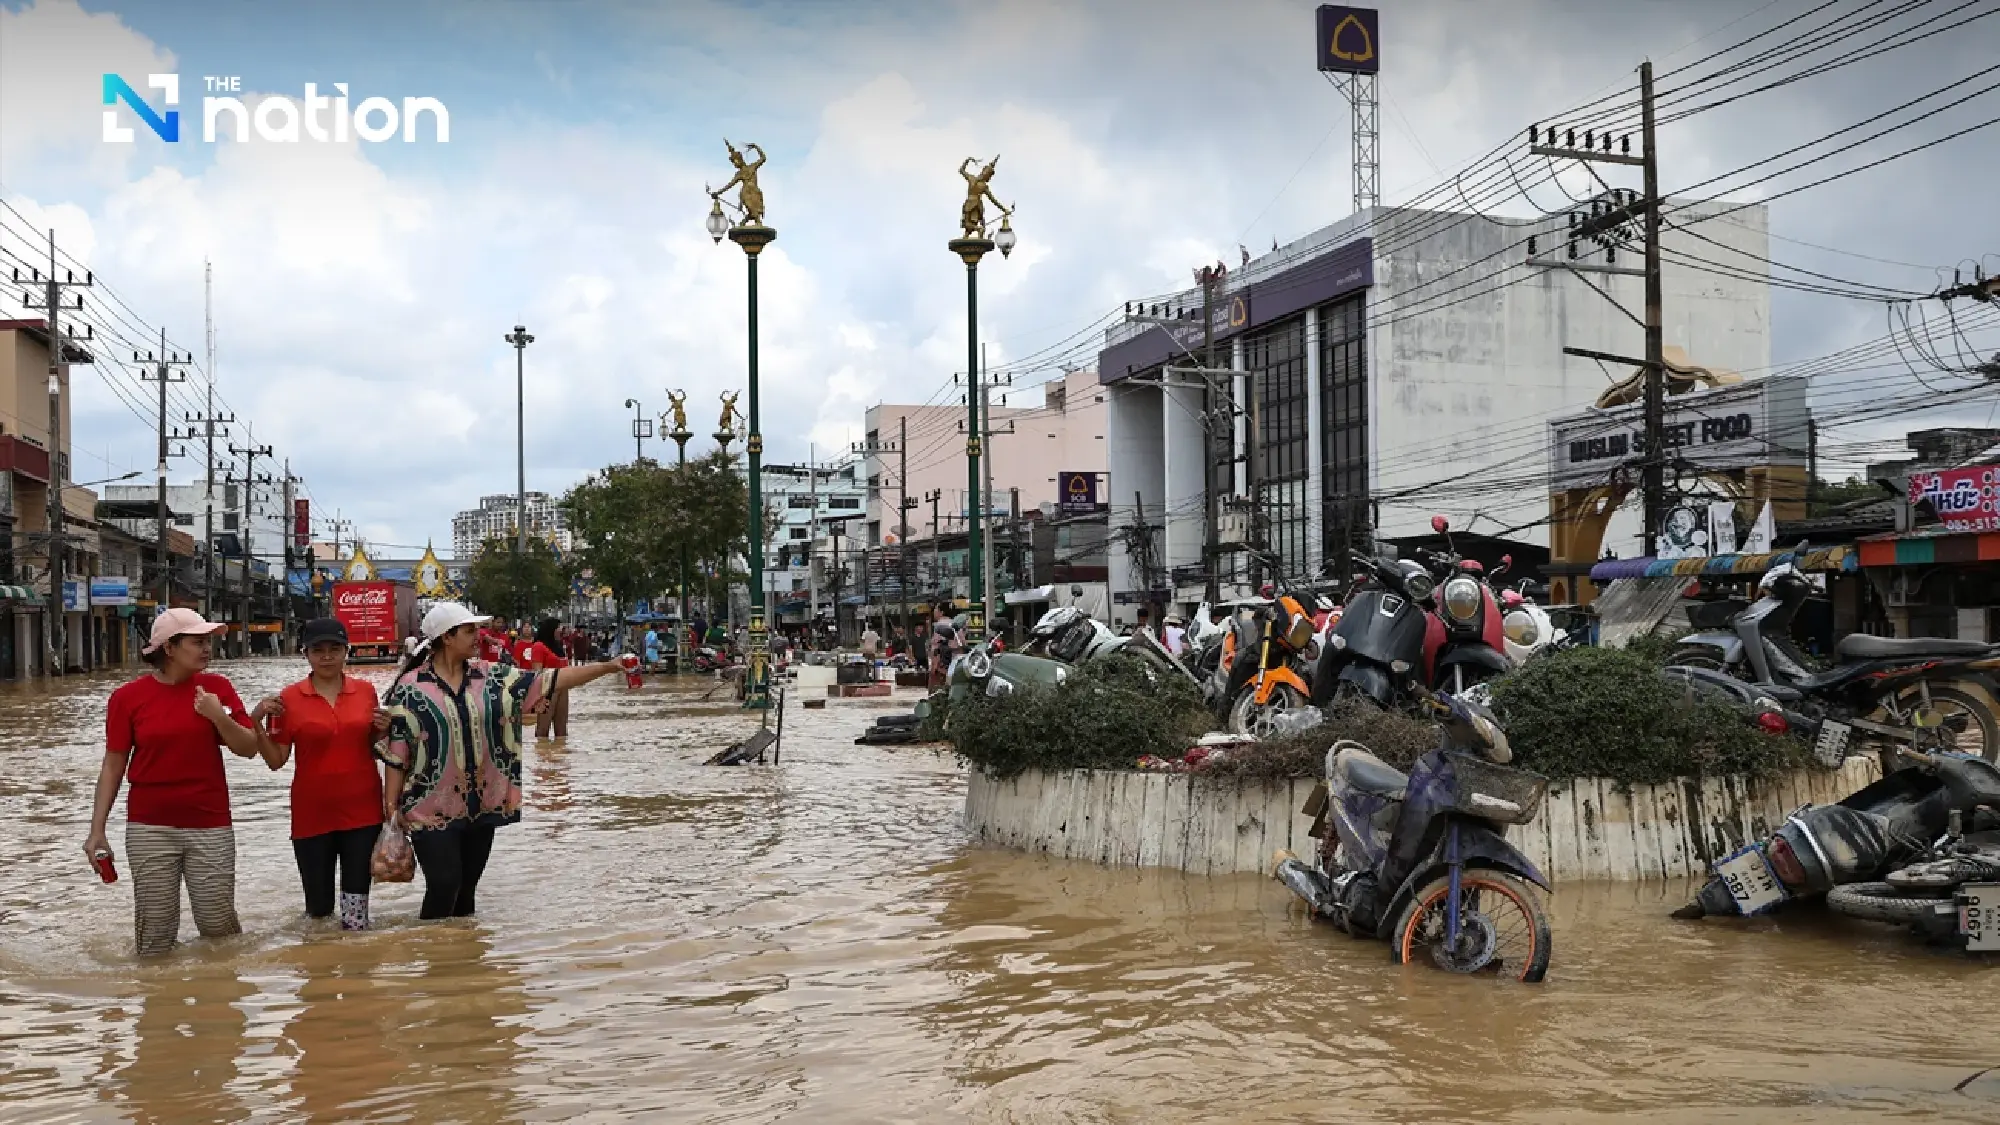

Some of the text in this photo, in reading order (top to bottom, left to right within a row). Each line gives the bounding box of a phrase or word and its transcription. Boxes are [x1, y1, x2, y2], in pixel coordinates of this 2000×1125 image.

[1570, 413, 1752, 463] MUSLIM SEET FOOD
[1725, 873, 1750, 901] 387
[1967, 895, 1982, 943] 9067
